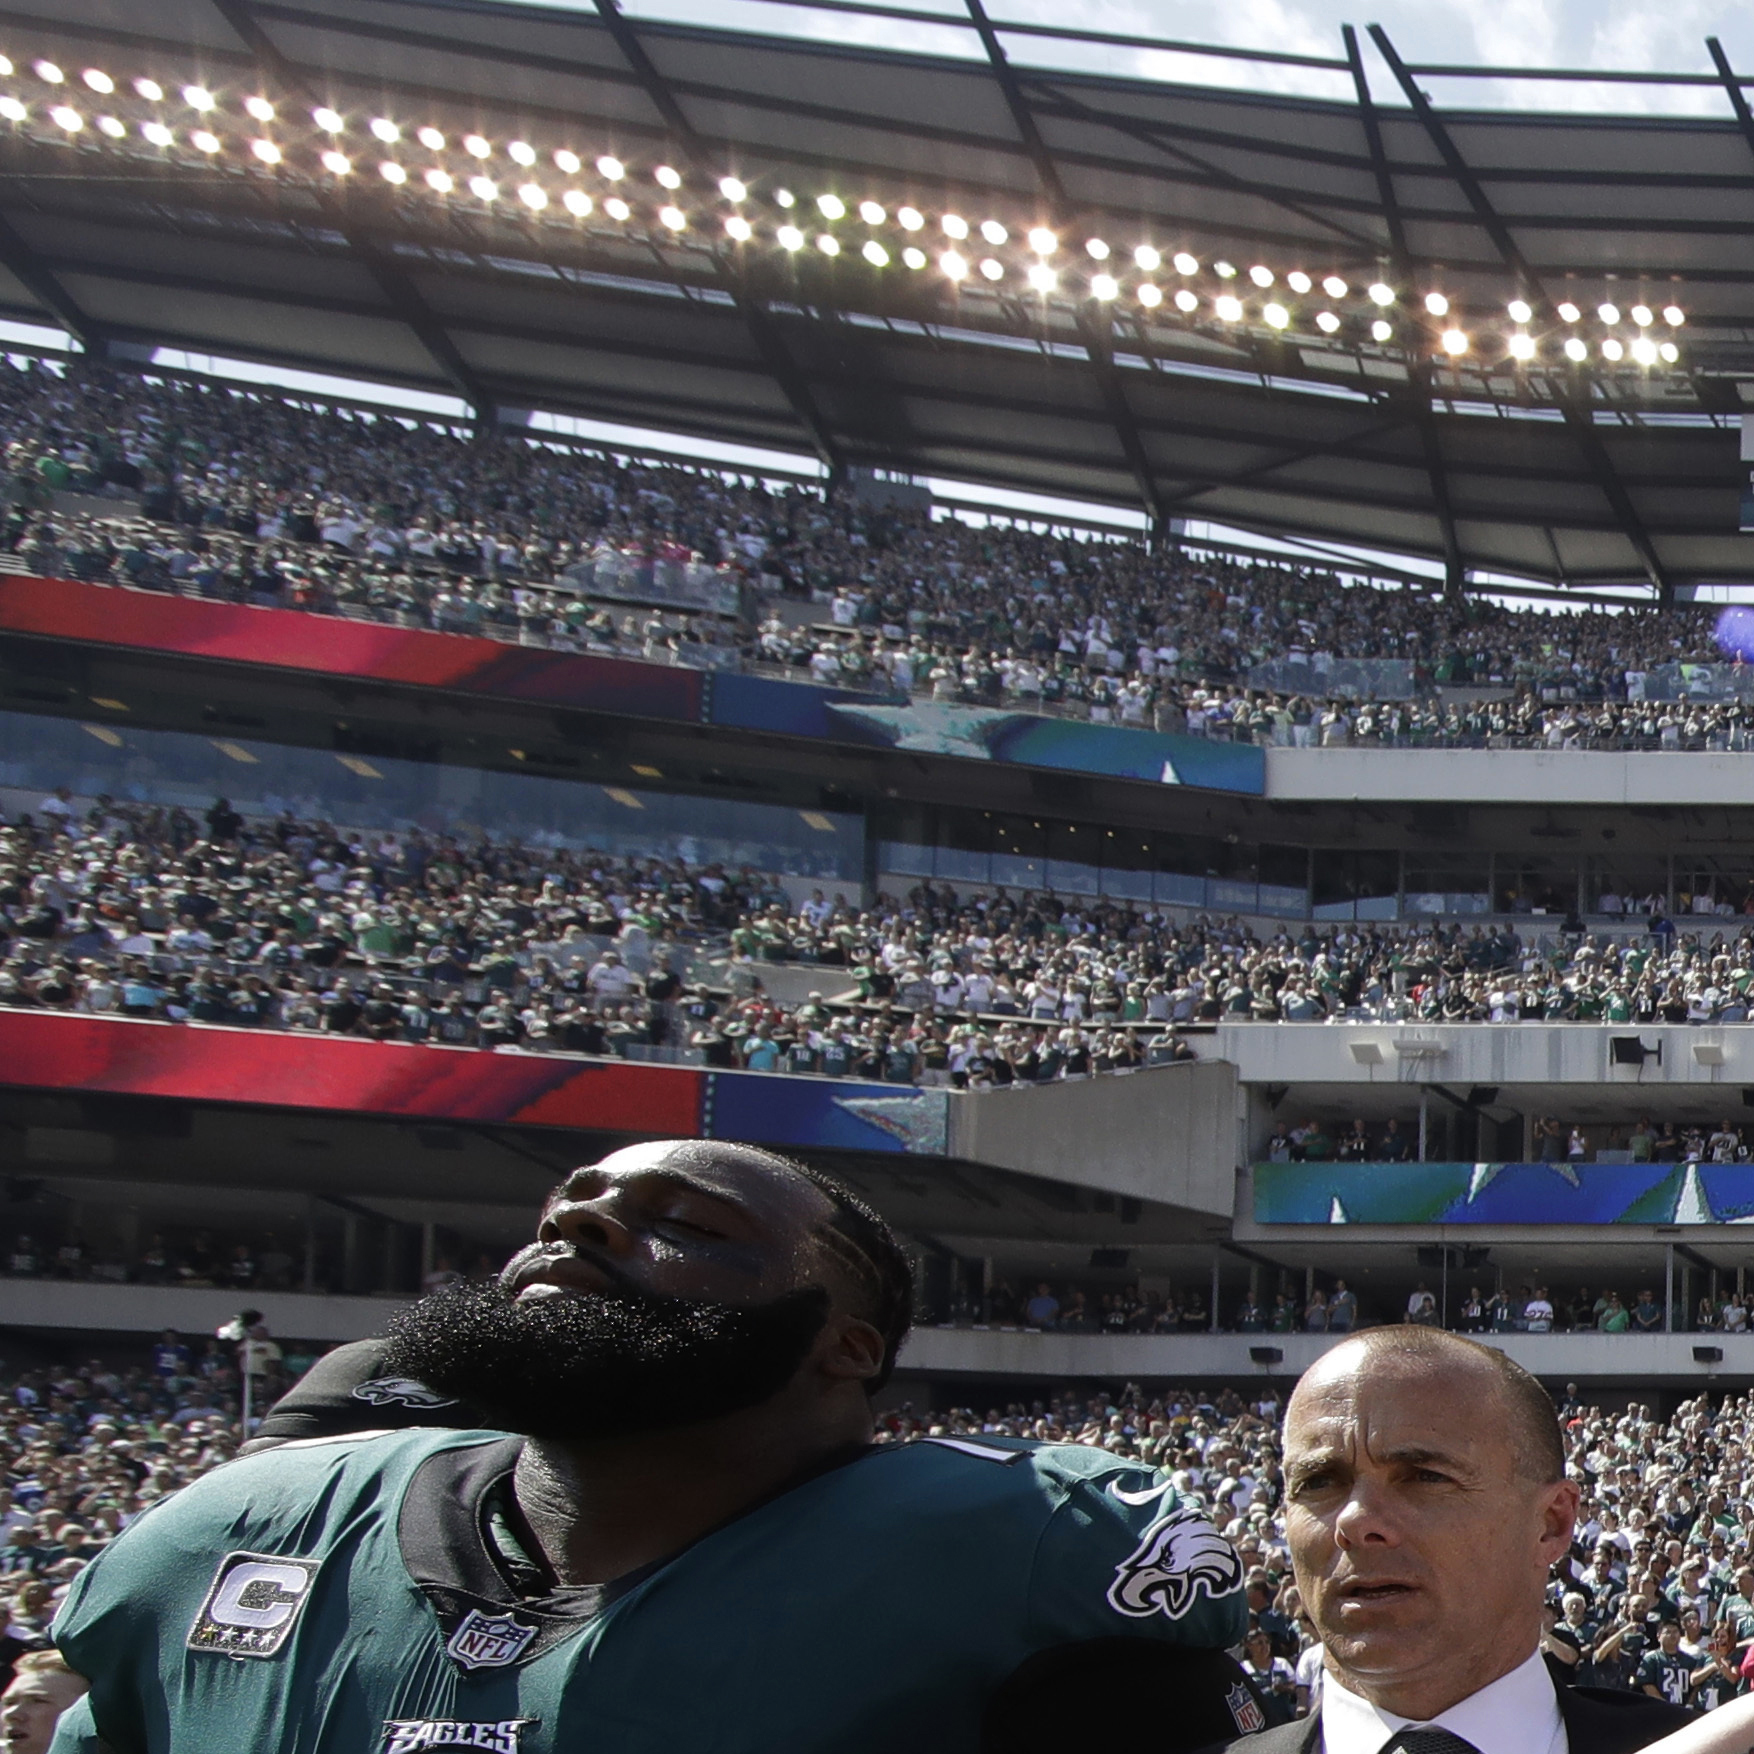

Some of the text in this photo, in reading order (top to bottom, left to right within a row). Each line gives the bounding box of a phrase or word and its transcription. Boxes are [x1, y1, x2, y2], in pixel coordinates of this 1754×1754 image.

[211, 1562, 309, 1630] C
[457, 1635, 515, 1661] NFL
[1237, 1707, 1264, 1730] NFL
